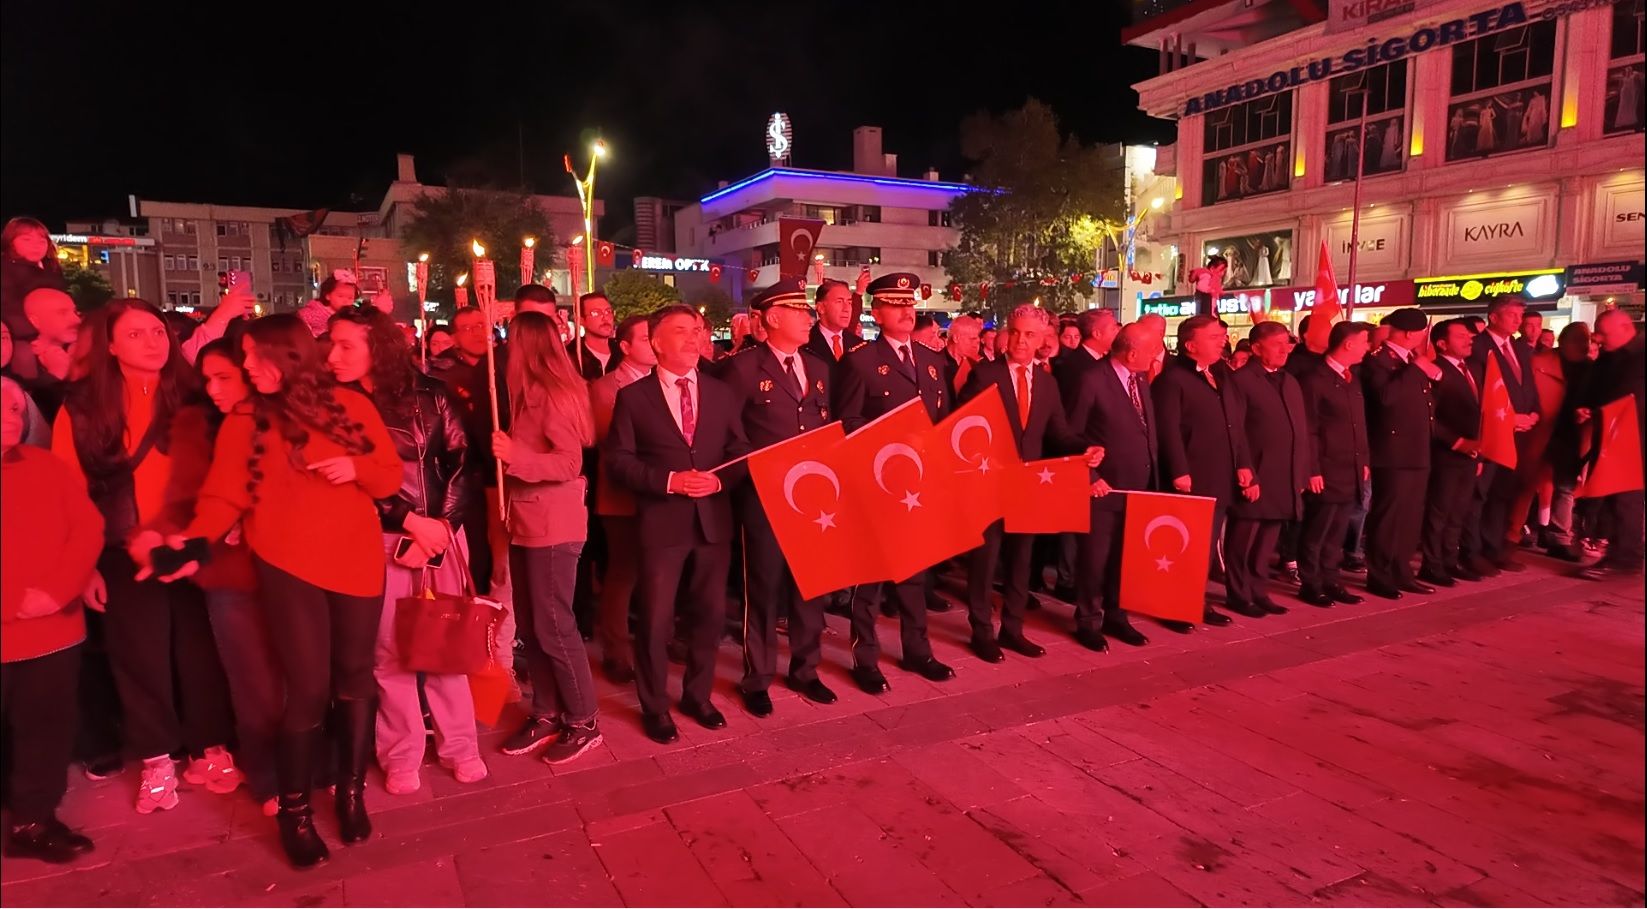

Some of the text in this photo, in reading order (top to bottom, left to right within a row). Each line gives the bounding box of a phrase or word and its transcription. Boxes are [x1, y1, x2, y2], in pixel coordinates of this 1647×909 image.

[1184, 1, 1528, 117] ANADOLU SİGORTA
[1464, 221, 1524, 242] KAYRA
[674, 257, 710, 271] OPTK
[1573, 264, 1632, 275] ANADOLU
